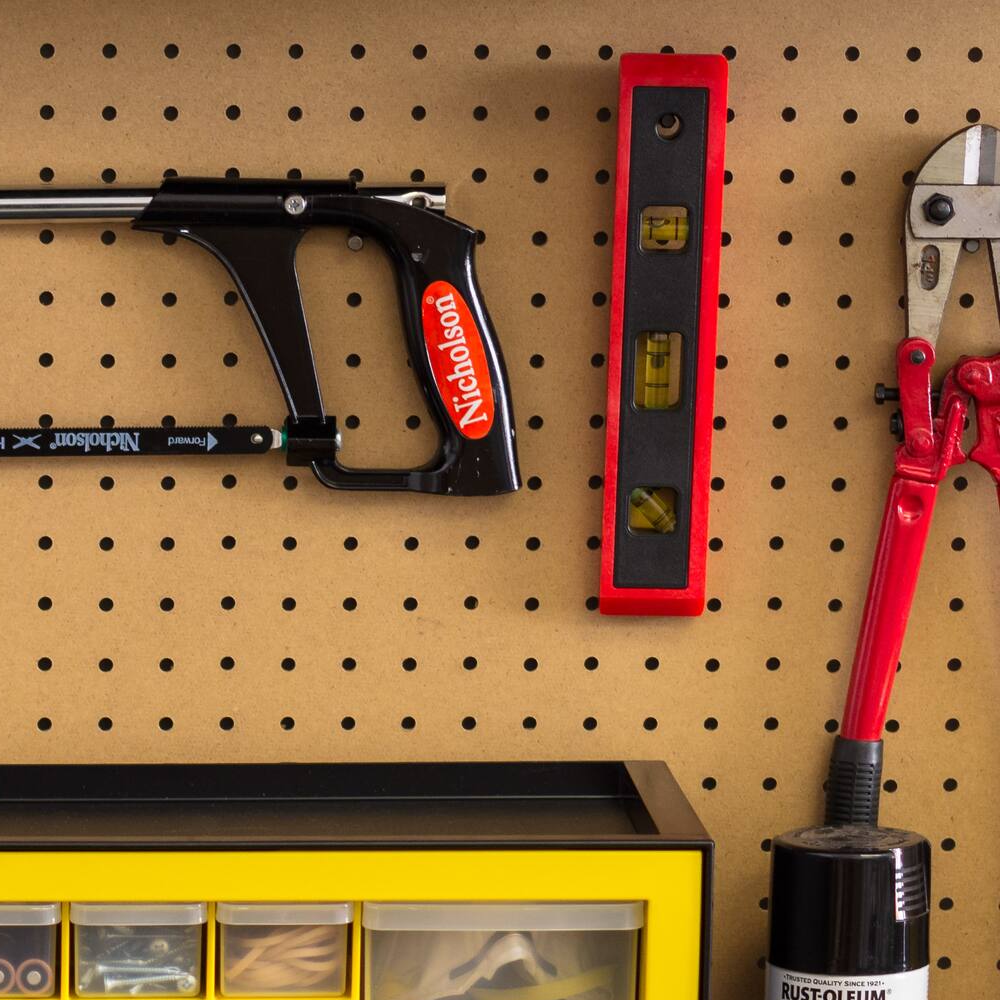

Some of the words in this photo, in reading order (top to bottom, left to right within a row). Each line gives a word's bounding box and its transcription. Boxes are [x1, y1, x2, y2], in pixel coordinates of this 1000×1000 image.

[435, 293, 488, 429] Nicholson
[55, 432, 140, 453] Nicholson
[168, 435, 206, 447] Forward
[786, 974, 812, 984] TRUSTED
[813, 979, 842, 987] QUALITY
